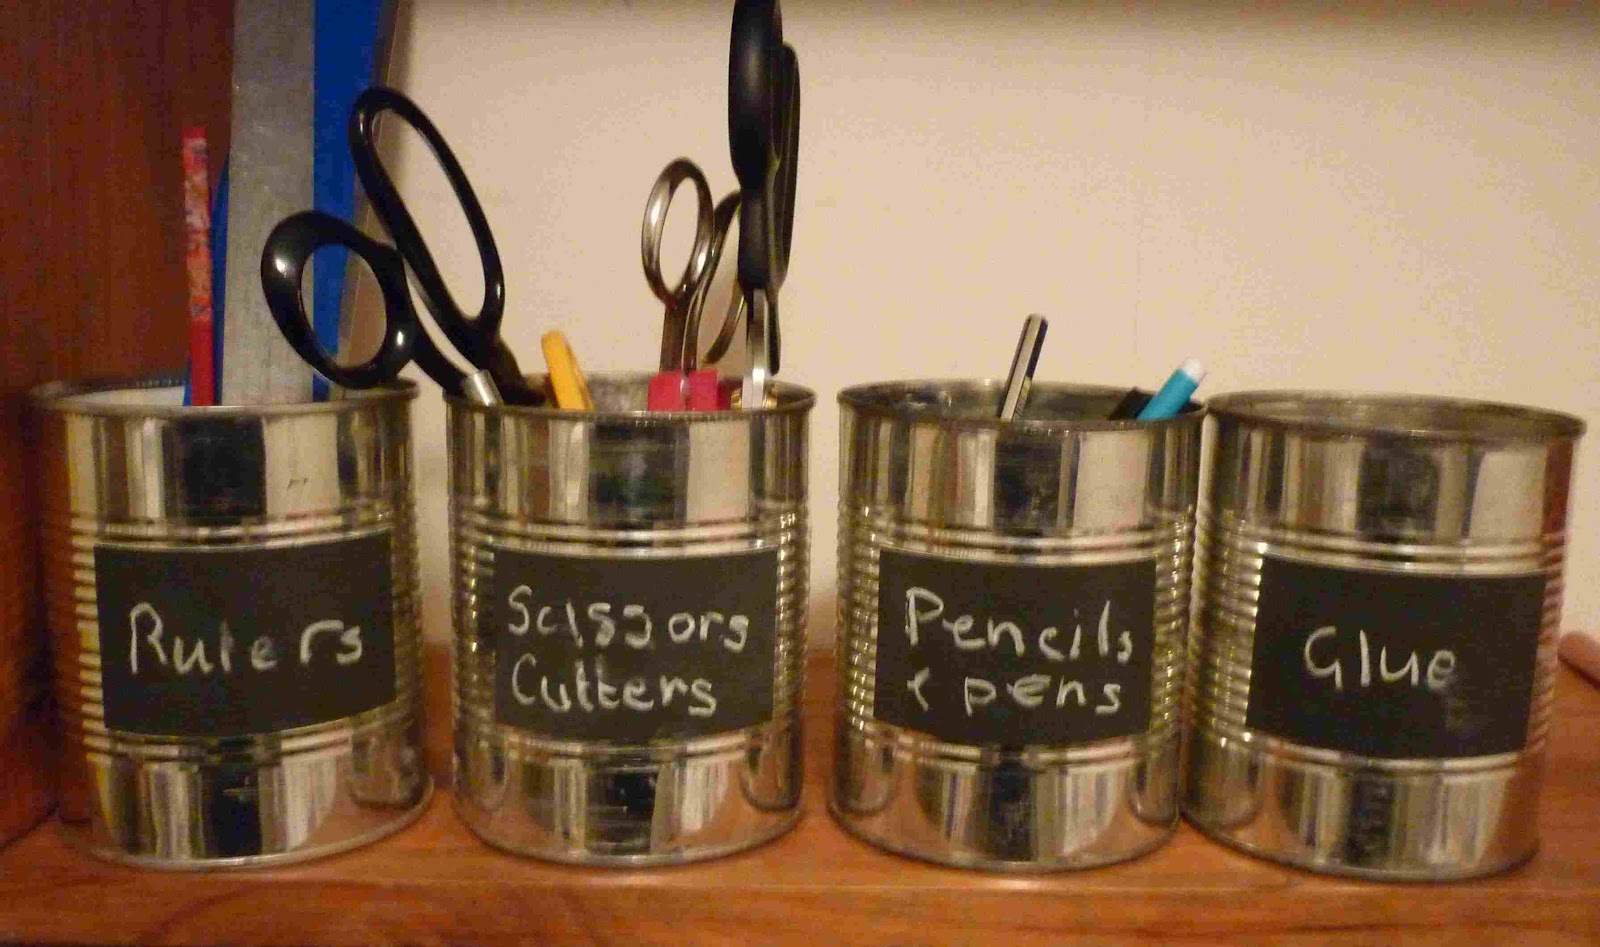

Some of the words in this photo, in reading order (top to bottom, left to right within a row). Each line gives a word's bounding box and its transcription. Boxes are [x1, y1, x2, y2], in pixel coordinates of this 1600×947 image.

[127, 602, 364, 677] Rulers
[507, 584, 751, 652] Scissors
[904, 586, 1134, 664] Pencils
[509, 653, 718, 717] Cutters
[1303, 627, 1457, 691] Glue
[963, 673, 1123, 717] pens
